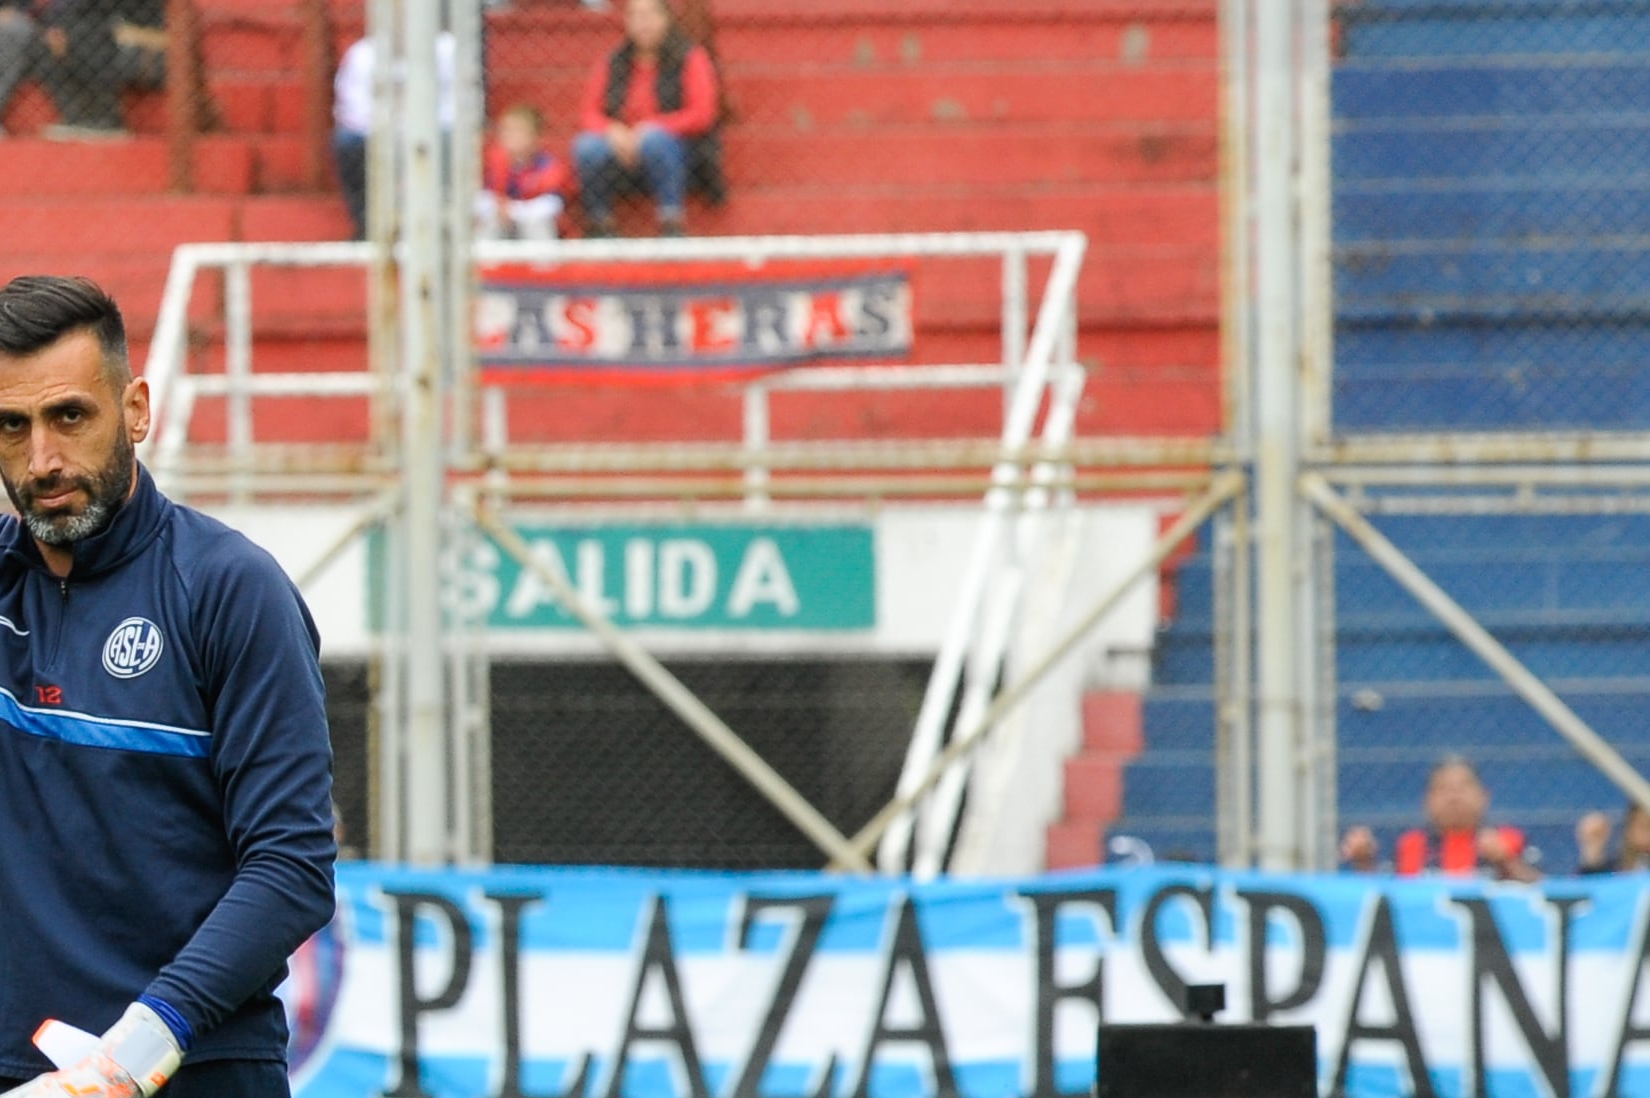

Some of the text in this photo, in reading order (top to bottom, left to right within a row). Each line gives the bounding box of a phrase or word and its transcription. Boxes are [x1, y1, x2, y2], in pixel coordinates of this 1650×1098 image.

[629, 290, 892, 351] HERAS
[440, 538, 802, 619] SALIDA
[34, 685, 62, 704] 12
